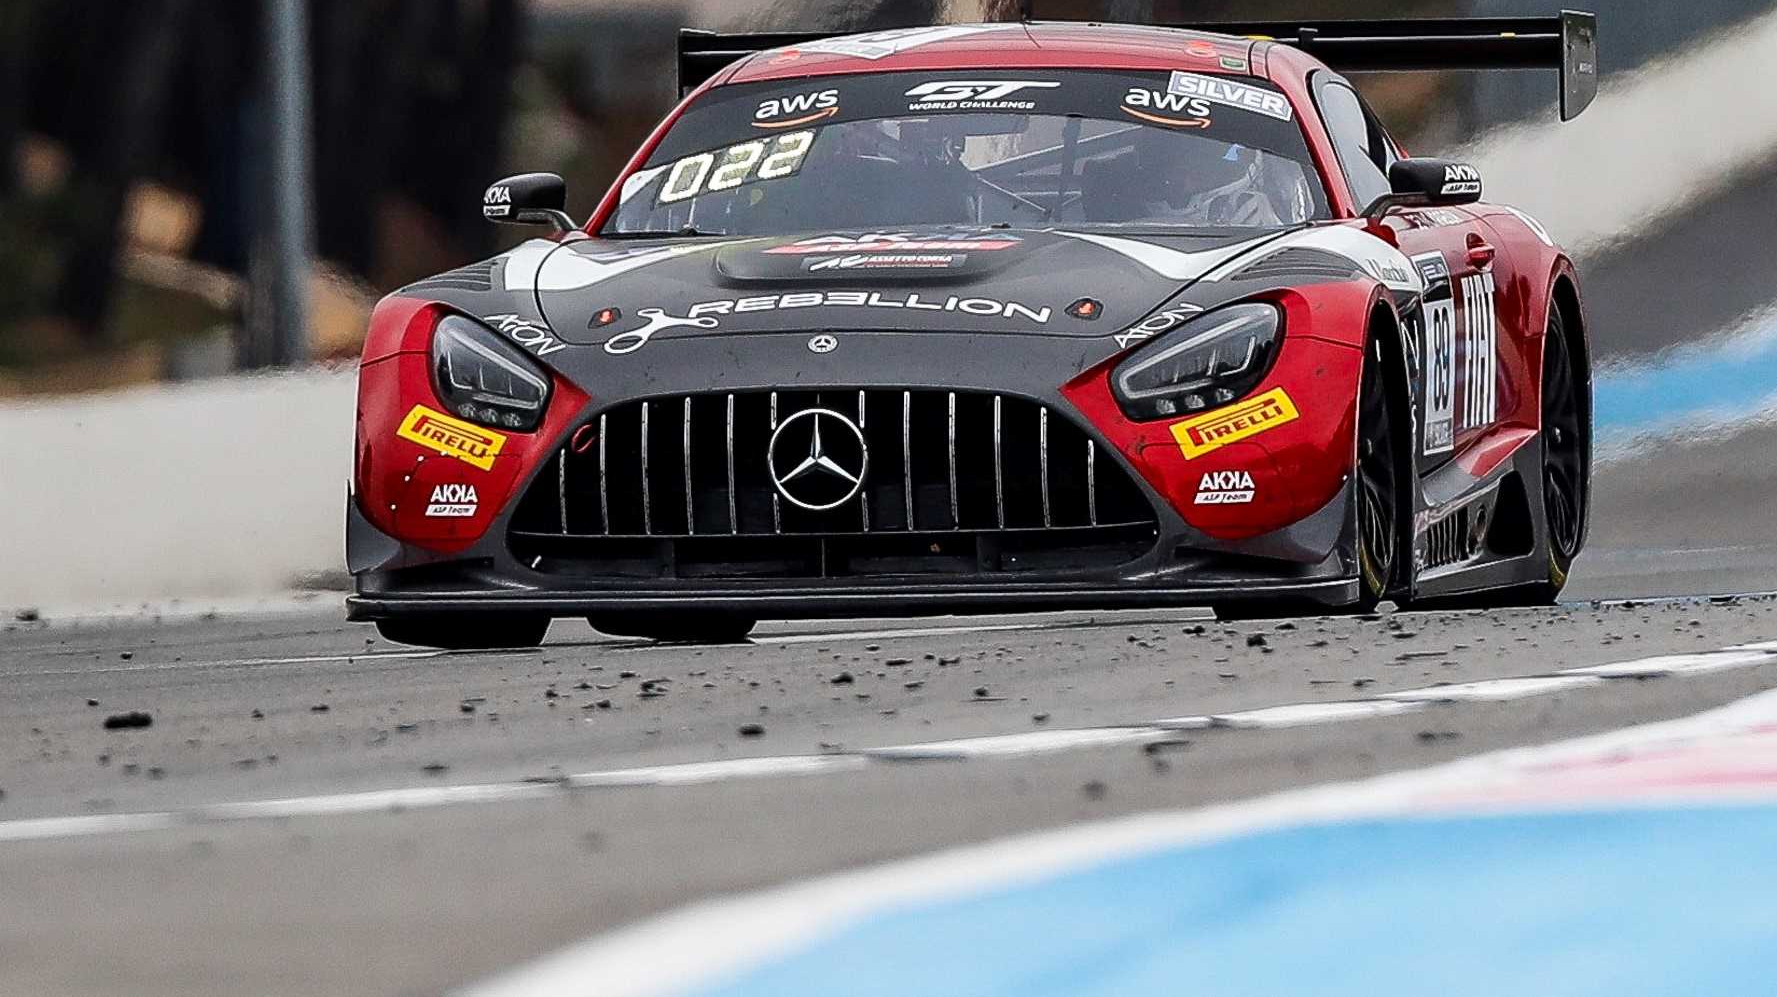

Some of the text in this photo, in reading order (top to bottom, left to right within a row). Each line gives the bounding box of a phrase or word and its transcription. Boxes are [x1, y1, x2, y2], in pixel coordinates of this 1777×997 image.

[755, 89, 838, 119] aws
[905, 81, 1061, 102] GT
[908, 101, 1036, 111] WORLD CHALLENGE
[1125, 88, 1210, 117] aws
[1178, 77, 1285, 114] SILVER
[659, 129, 816, 203] 022
[688, 291, 1052, 323] REBELLION
[1433, 306, 1451, 412] 89
[411, 414, 494, 459] PIRELLI
[1185, 397, 1284, 448] PIRELLI
[430, 483, 478, 503] AKKA
[1199, 470, 1256, 491] AKKA
